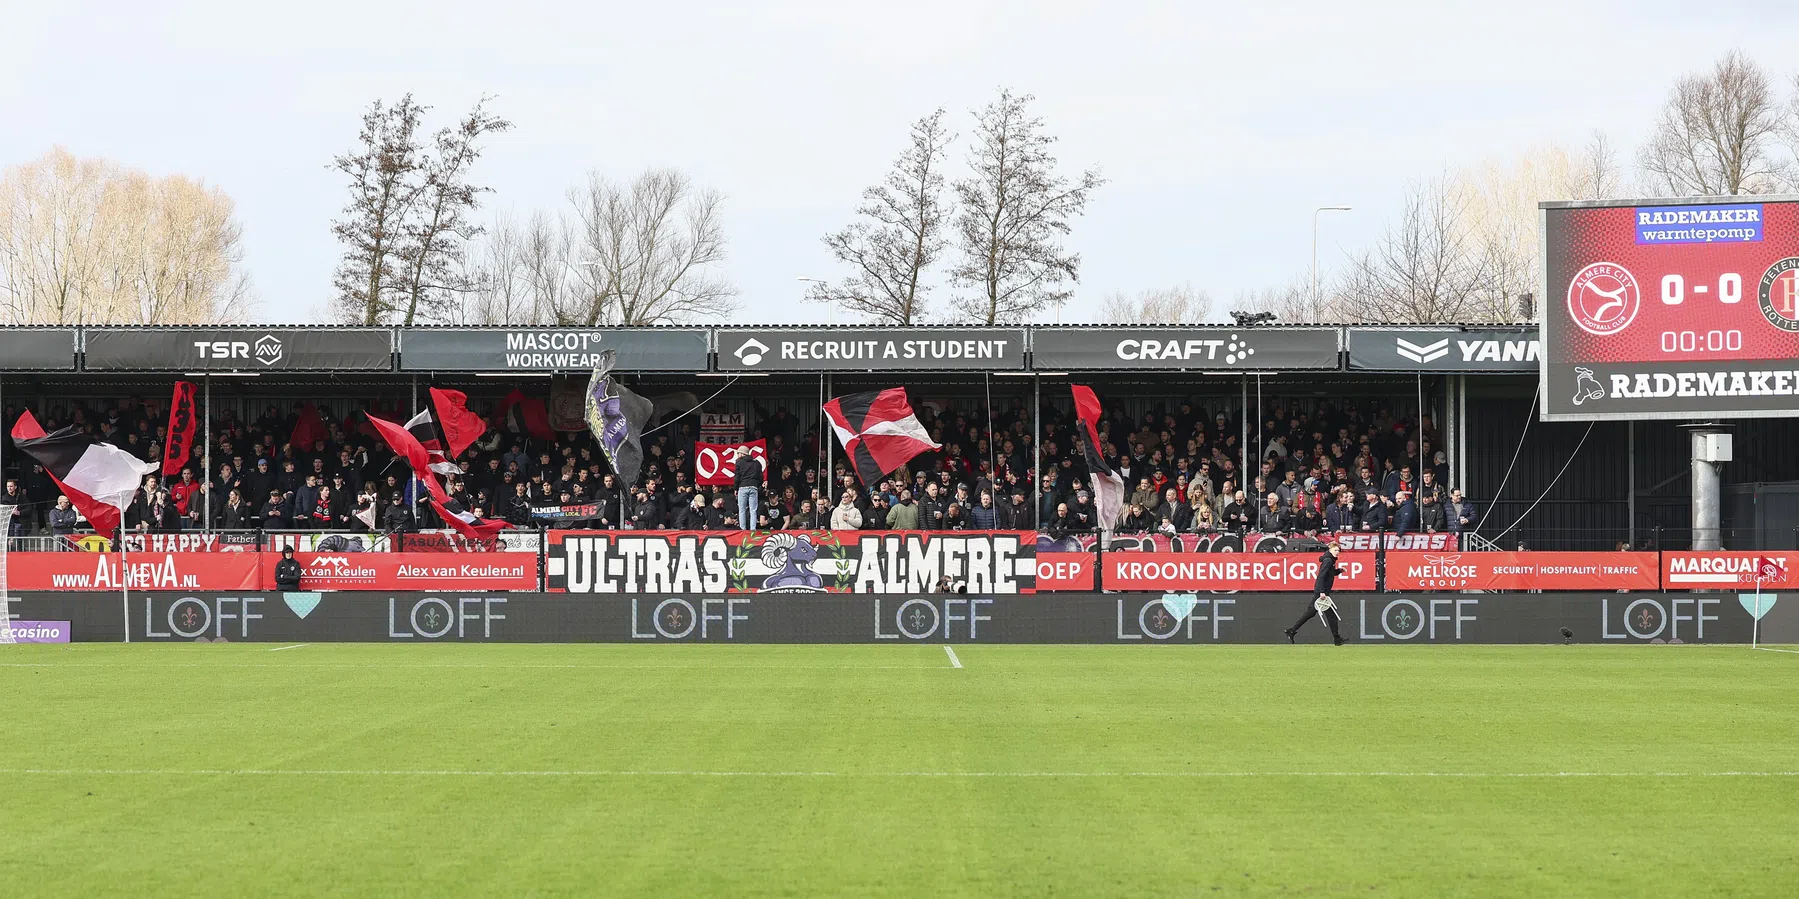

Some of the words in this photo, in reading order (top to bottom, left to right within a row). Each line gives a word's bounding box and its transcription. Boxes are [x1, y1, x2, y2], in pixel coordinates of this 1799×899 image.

[1638, 209, 1760, 225] RADEMAKER
[1643, 228, 1756, 242] warmtepomp
[1576, 266, 1611, 289] ALMERE
[1614, 270, 1632, 288] CITY
[1763, 260, 1799, 285] FEYEN
[1661, 274, 1684, 305] 0
[1719, 273, 1742, 304] 0
[1582, 317, 1611, 330] FOOTBALL
[1612, 315, 1626, 327] CLUB
[194, 341, 249, 358] TSR
[781, 340, 878, 359] RECRUIT
[882, 341, 899, 359] A
[903, 340, 1008, 359] STUDENT
[1116, 339, 1225, 360] CRAFT
[1661, 330, 1742, 352] 00:00
[506, 354, 600, 367] WORKWEAR
[1610, 370, 1799, 398] RADEMAKE
[706, 414, 741, 424] ALM
[531, 506, 560, 514] ALMERE
[580, 505, 597, 516] FC
[152, 534, 216, 552] HAPPY
[226, 535, 256, 543] Father
[1338, 534, 1447, 550] SENIORS
[335, 566, 376, 576] Keulen
[397, 565, 428, 576] Alex
[432, 567, 456, 576] van
[461, 565, 524, 576] Keulen.nl
[565, 537, 728, 593] ULTRAS
[854, 537, 1017, 594] ALMERE
[1289, 562, 1362, 580] GREP
[1408, 565, 1477, 578] MELROSE
[1492, 566, 1534, 574] SECURITY
[1540, 566, 1596, 574] HOSPITALITY
[1603, 566, 1638, 574] TRAFFIC
[1419, 579, 1467, 587] GROUP
[146, 597, 265, 639] LOFF
[388, 597, 507, 639] LOFF
[632, 598, 750, 639] LOFF
[875, 598, 994, 639] LOFF
[1117, 598, 1236, 639] LOFF
[1360, 599, 1479, 639] LOFF
[1602, 599, 1720, 639] LOFF
